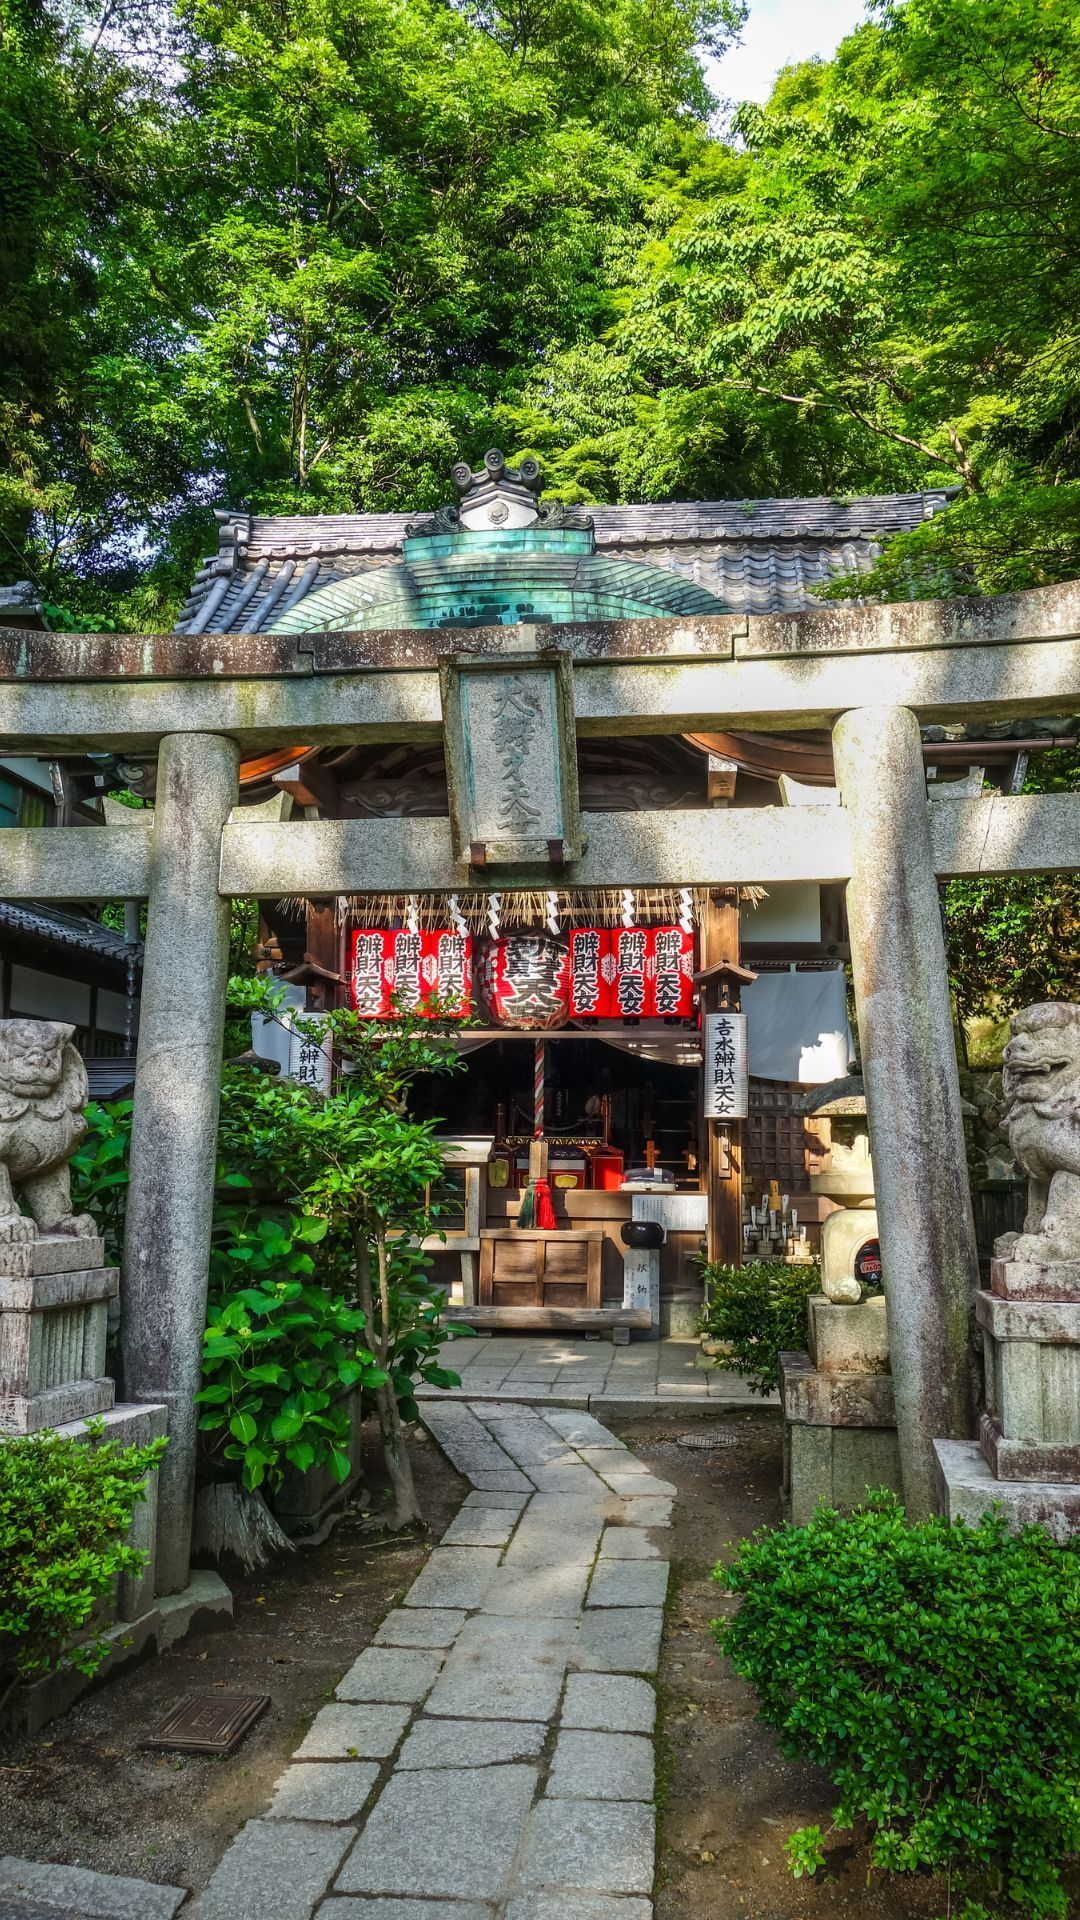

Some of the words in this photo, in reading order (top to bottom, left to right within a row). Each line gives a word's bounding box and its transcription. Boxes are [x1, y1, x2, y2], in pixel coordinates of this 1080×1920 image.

[356, 934, 383, 1013] 辨財天女
[573, 932, 599, 1013] 辨財天女
[618, 932, 646, 1014] 辨財天女
[655, 932, 682, 1013] 辨財天女
[714, 1018, 736, 1115] 吉水辨財天女
